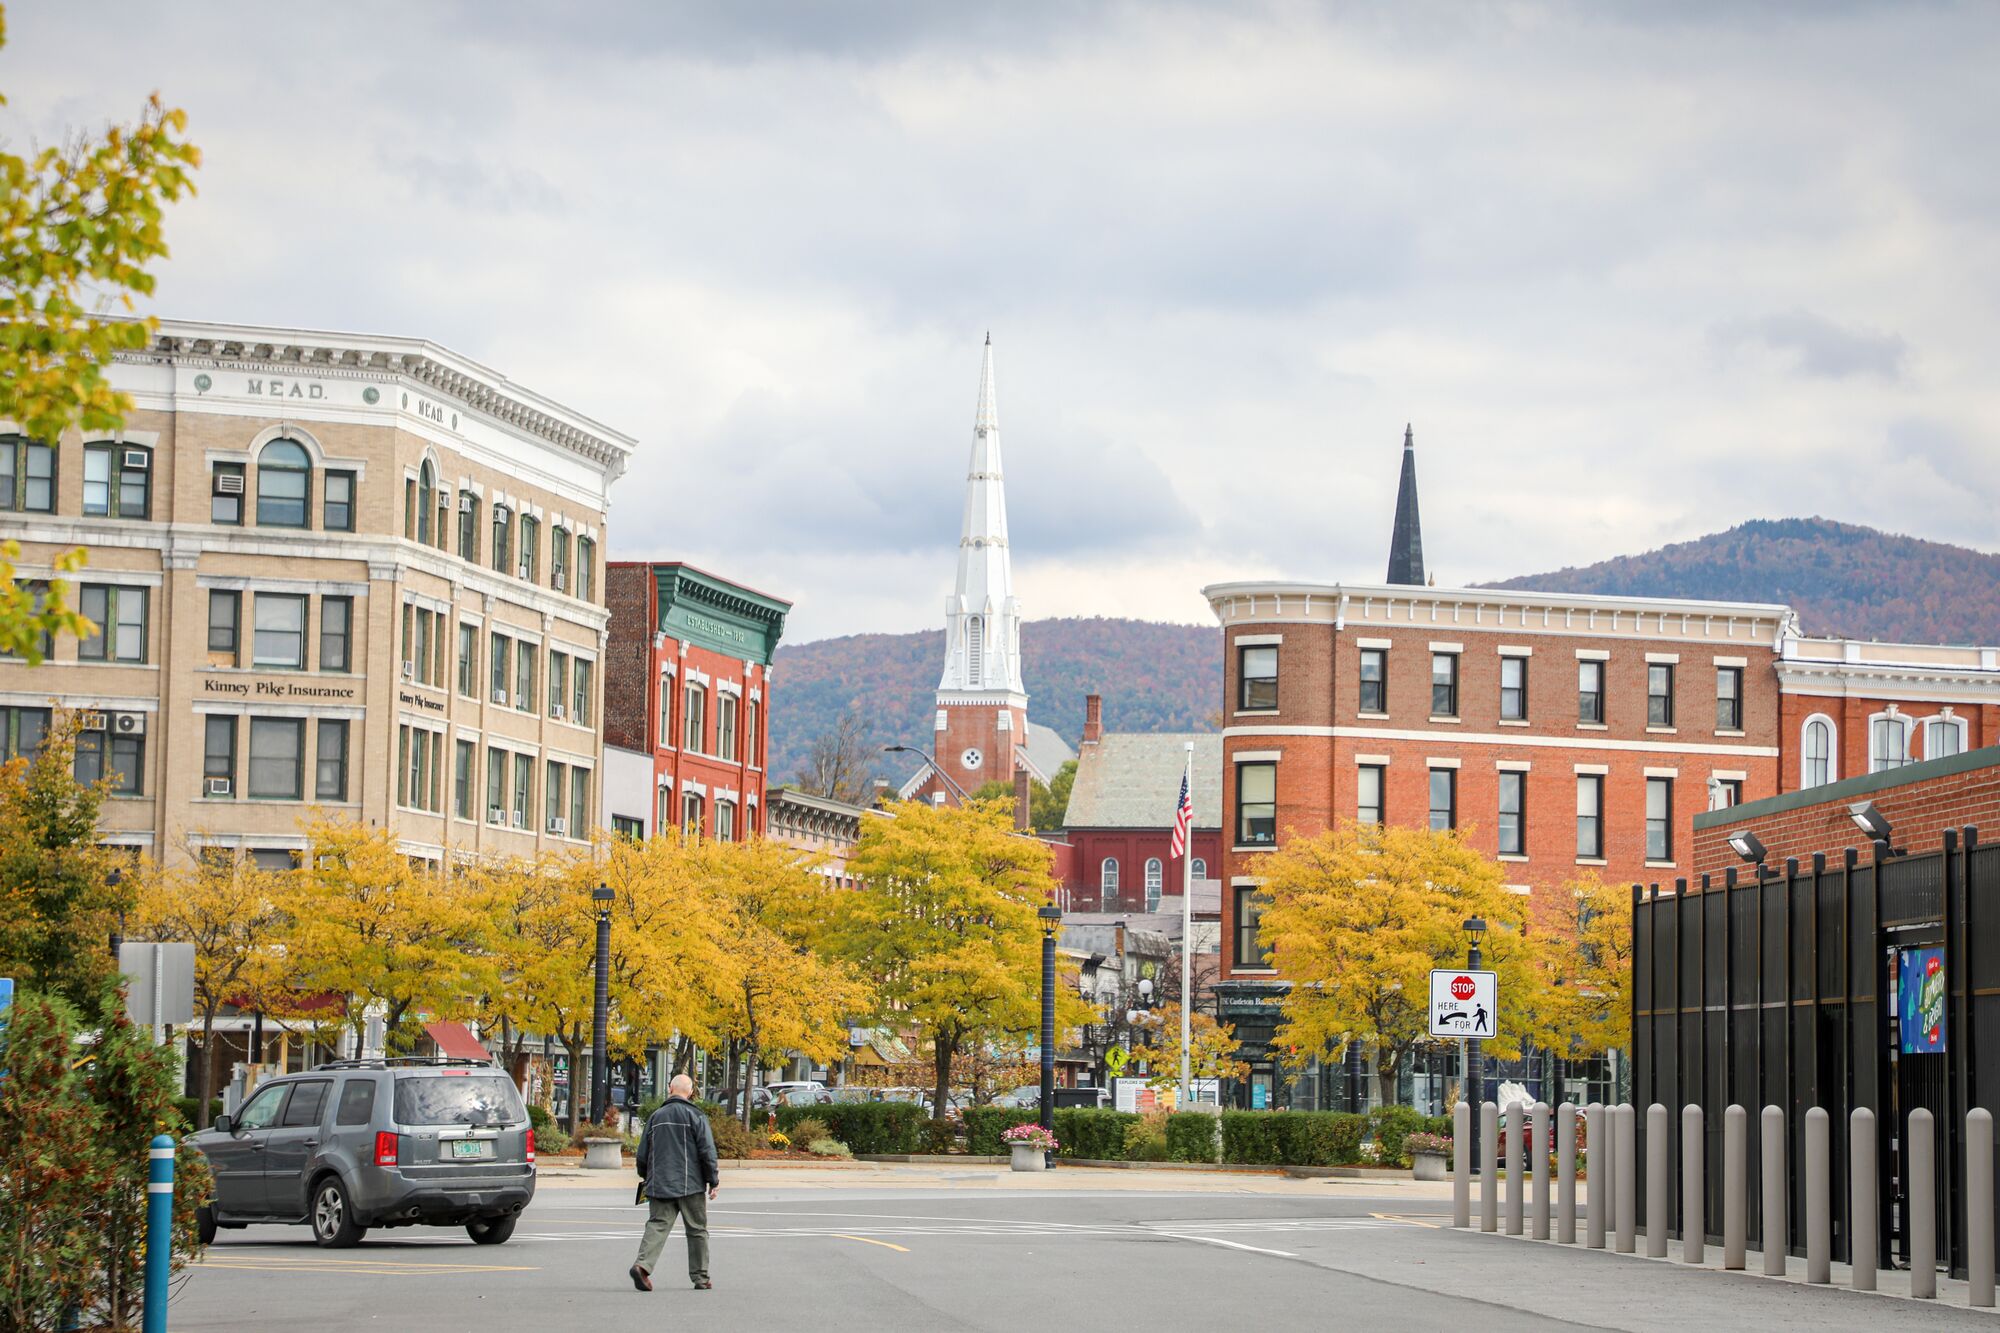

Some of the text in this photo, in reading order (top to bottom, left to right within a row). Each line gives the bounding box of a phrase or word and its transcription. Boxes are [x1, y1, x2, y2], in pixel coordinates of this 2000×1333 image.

[248, 379, 328, 400] MEAD.
[418, 400, 444, 423] MEAD.
[687, 614, 724, 637] ESTABLISHED
[205, 679, 354, 698] Kinney Pike Insurance
[1451, 983, 1475, 994] STOP
[1437, 1002, 1459, 1011] HERE
[1454, 1020, 1471, 1030] FOR
